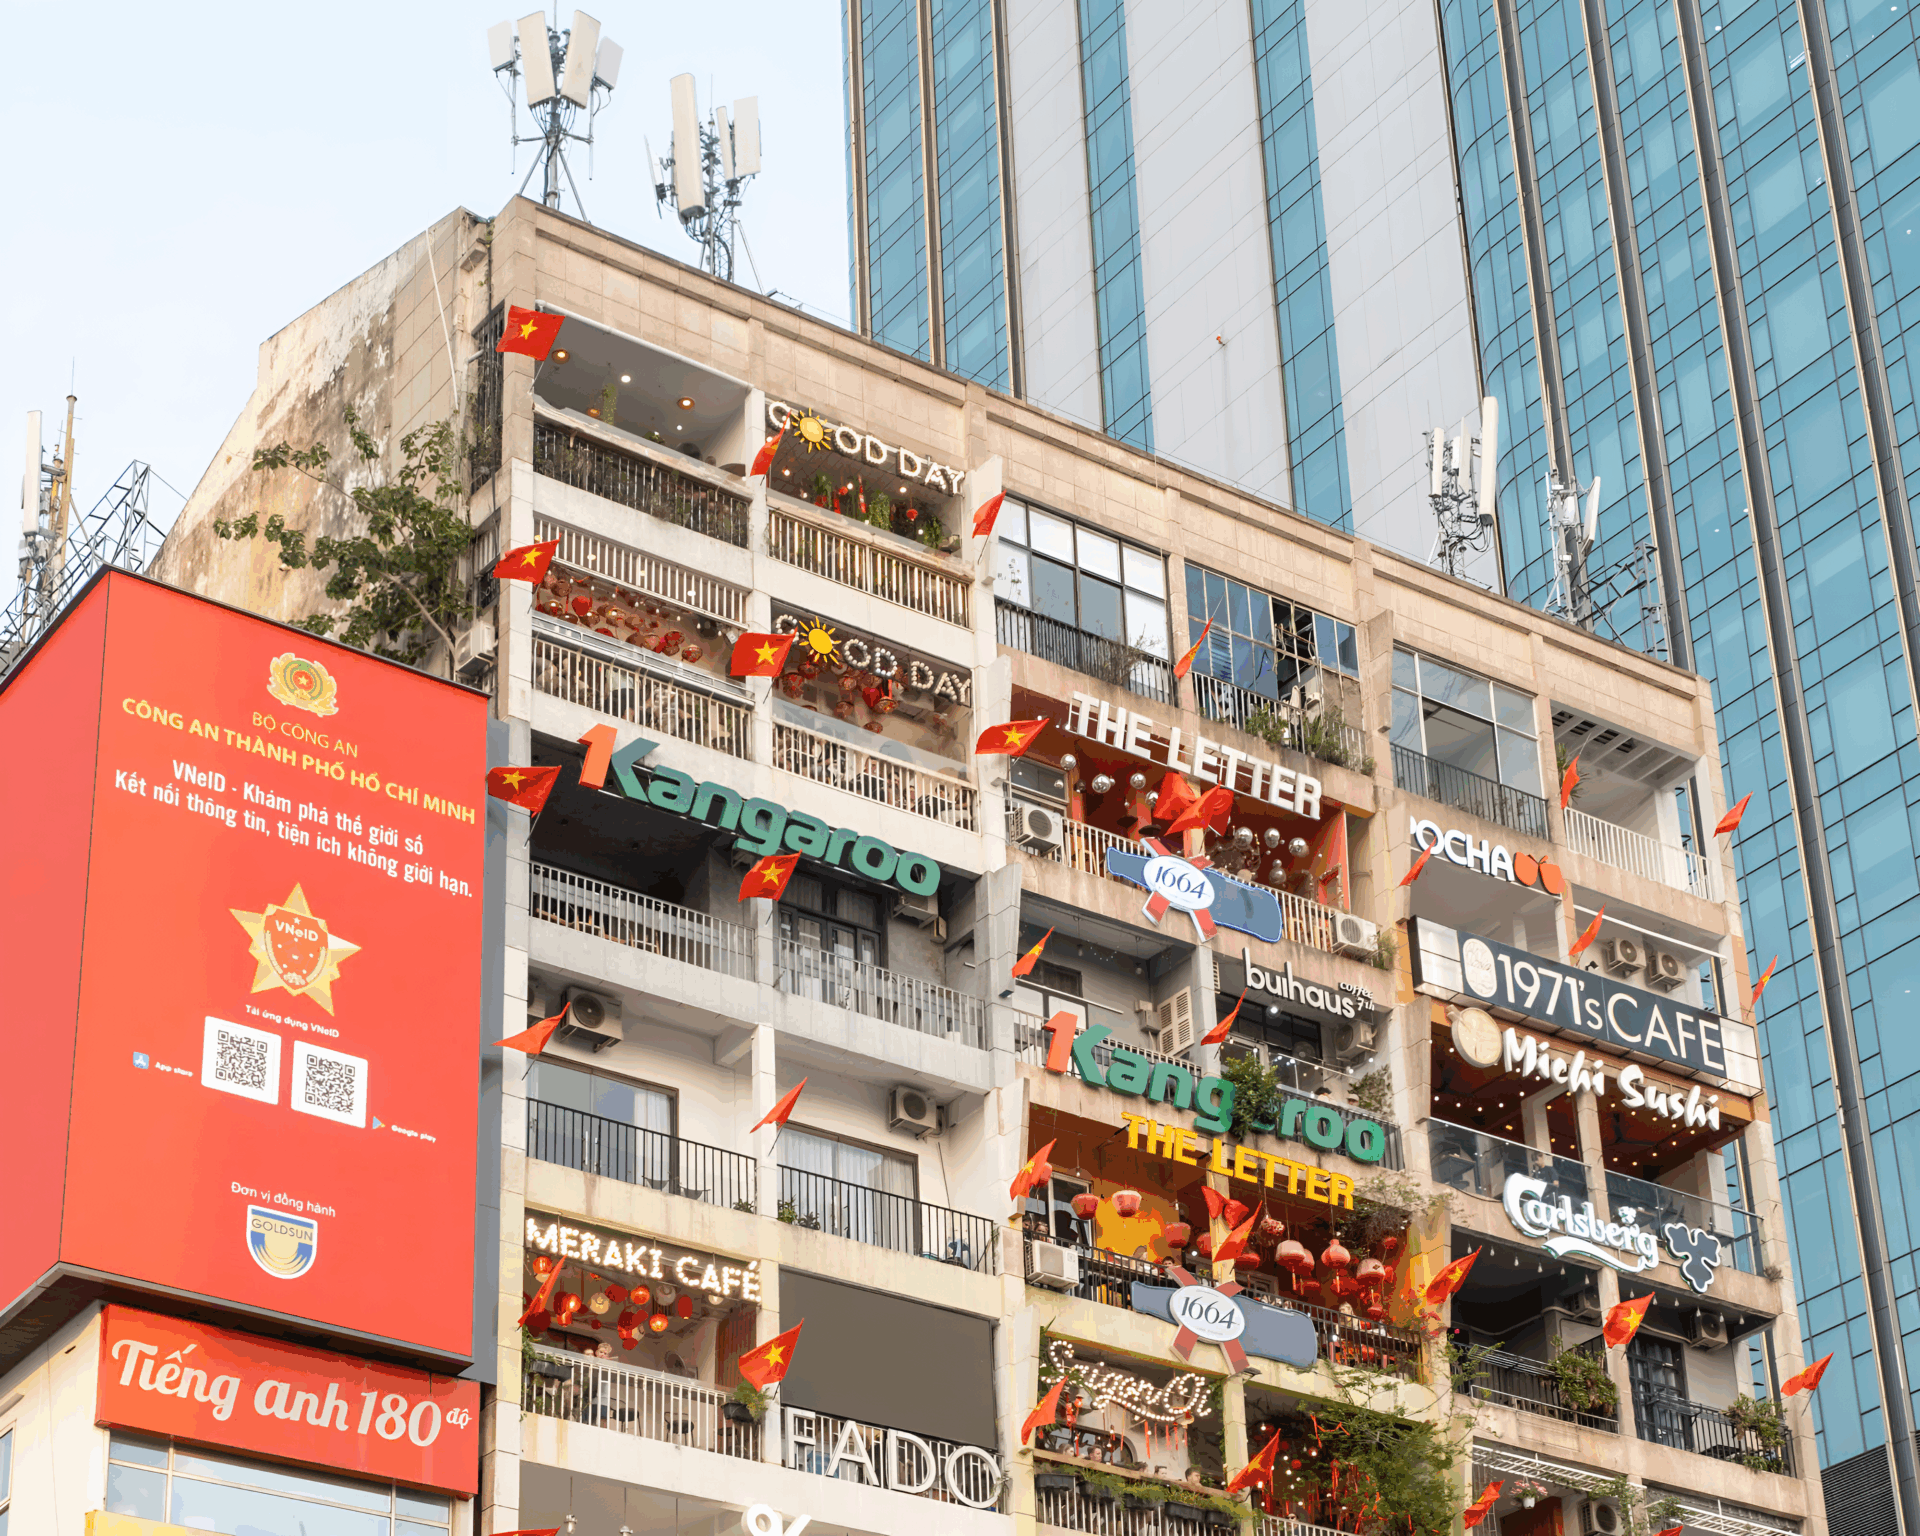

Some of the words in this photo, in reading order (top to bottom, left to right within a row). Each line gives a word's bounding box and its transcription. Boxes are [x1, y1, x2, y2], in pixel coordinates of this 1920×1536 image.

[900, 447, 964, 494] DAY
[911, 661, 971, 703] DAY
[123, 698, 183, 729] CÔNG
[189, 719, 219, 741] AN
[224, 728, 297, 766] THÀNH
[302, 754, 345, 780] PHỐ
[386, 782, 419, 805] CHÍ
[423, 794, 475, 824] MINH
[253, 712, 276, 733] BỘ
[281, 722, 329, 748] CÔNG
[334, 739, 358, 758] AN
[1072, 691, 1152, 760] THE
[1167, 727, 1322, 820] LETTER
[115, 769, 147, 797] Kết
[154, 783, 179, 806] nối
[186, 792, 237, 828] thông
[243, 810, 270, 837] tin,
[277, 821, 309, 846] tiện
[348, 841, 398, 878] không
[439, 870, 472, 897] hạn.
[173, 759, 226, 792] VNeID
[335, 812, 362, 835] thế
[405, 834, 423, 855] số
[577, 723, 941, 896] Kangaroo
[1155, 866, 1208, 898] 1664
[1243, 947, 1355, 1018] buihaus
[1503, 1028, 1604, 1096] Michi
[1617, 1064, 1719, 1130] Sushi
[1608, 993, 1724, 1071] CAFE
[1042, 1011, 1385, 1162] Kangroo
[1121, 1112, 1199, 1166] THE
[1212, 1138, 1354, 1210] LETTER
[252, 1218, 313, 1241] GOLDSUN
[526, 1218, 662, 1279] MERAKI
[1503, 1173, 1660, 1272] Carlsberg
[1181, 1296, 1240, 1329] 1664
[112, 1339, 241, 1421] Tiếng
[254, 1380, 349, 1431] anh
[357, 1391, 442, 1447] 180
[446, 1407, 472, 1429] độ
[784, 1406, 1002, 1509] FADO
